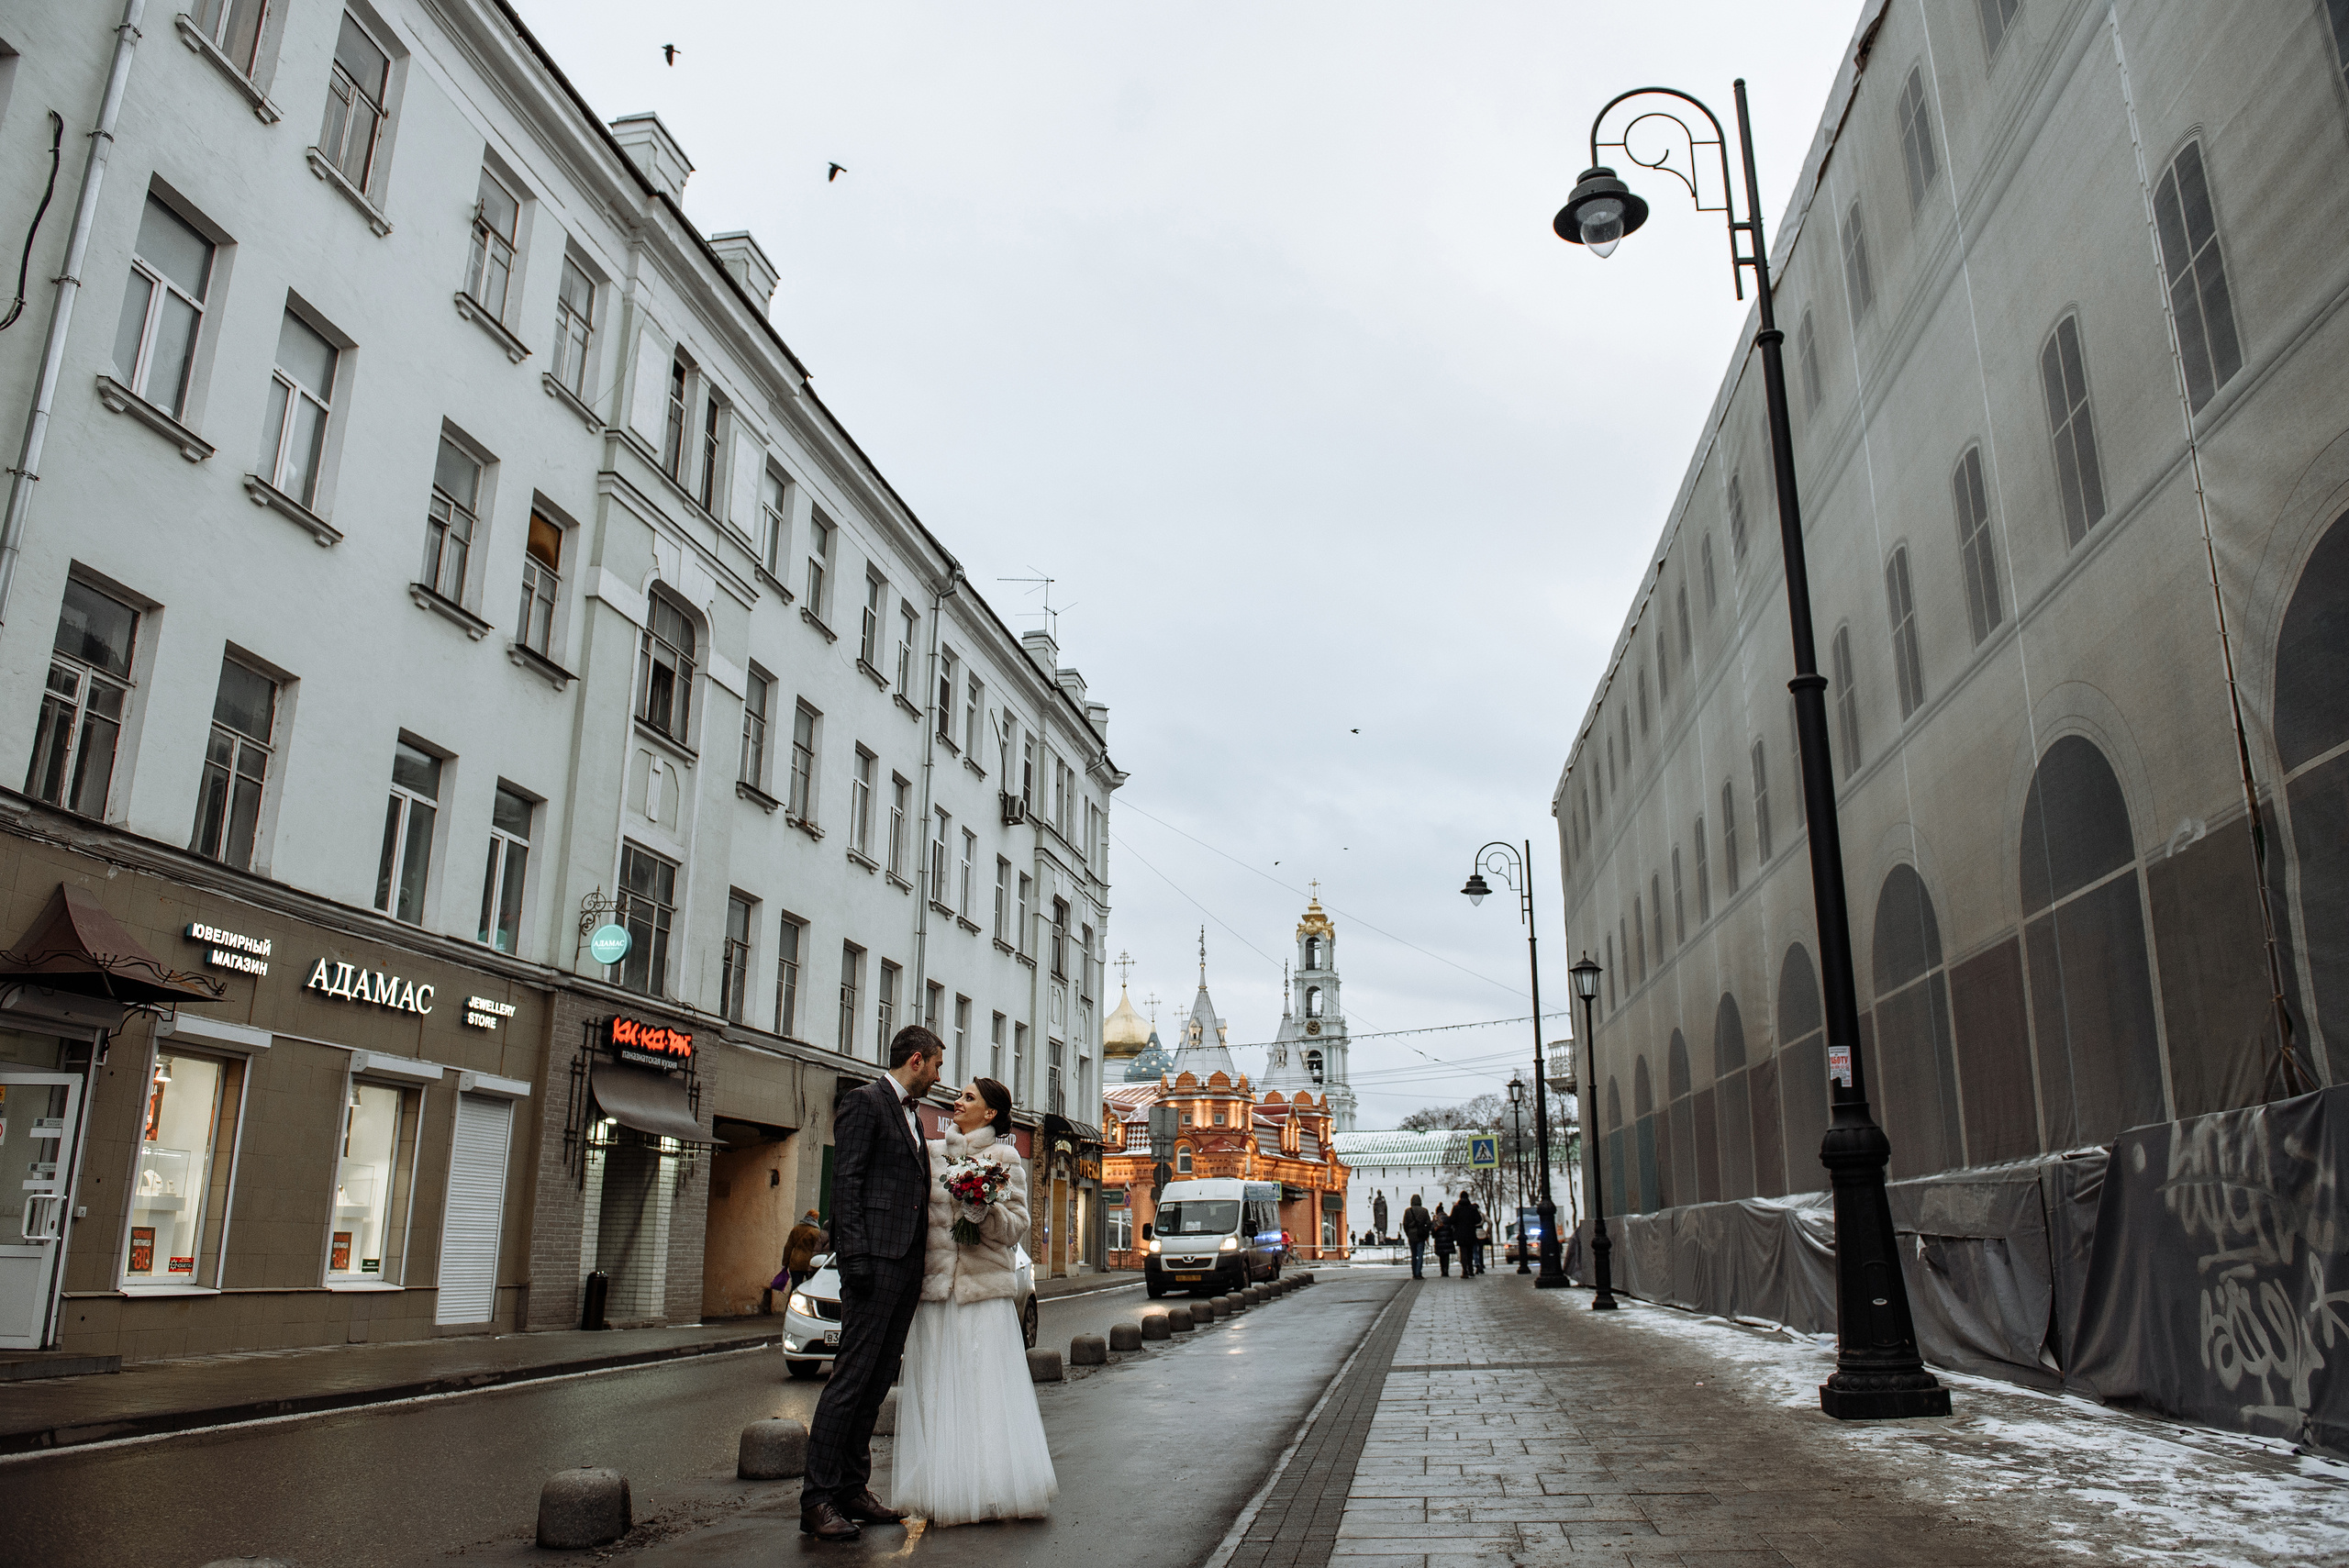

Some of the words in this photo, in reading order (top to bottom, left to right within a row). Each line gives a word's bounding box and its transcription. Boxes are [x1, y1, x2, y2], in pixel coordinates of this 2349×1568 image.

[192, 922, 272, 956] ЮВЕЛИРНЫЙ
[212, 950, 268, 976] МАГАЗИН
[307, 957, 435, 1015] АДАМАС
[468, 995, 516, 1018] JEWELLERY
[467, 1011, 496, 1029] STORE
[661, 1058, 678, 1070] кухня
